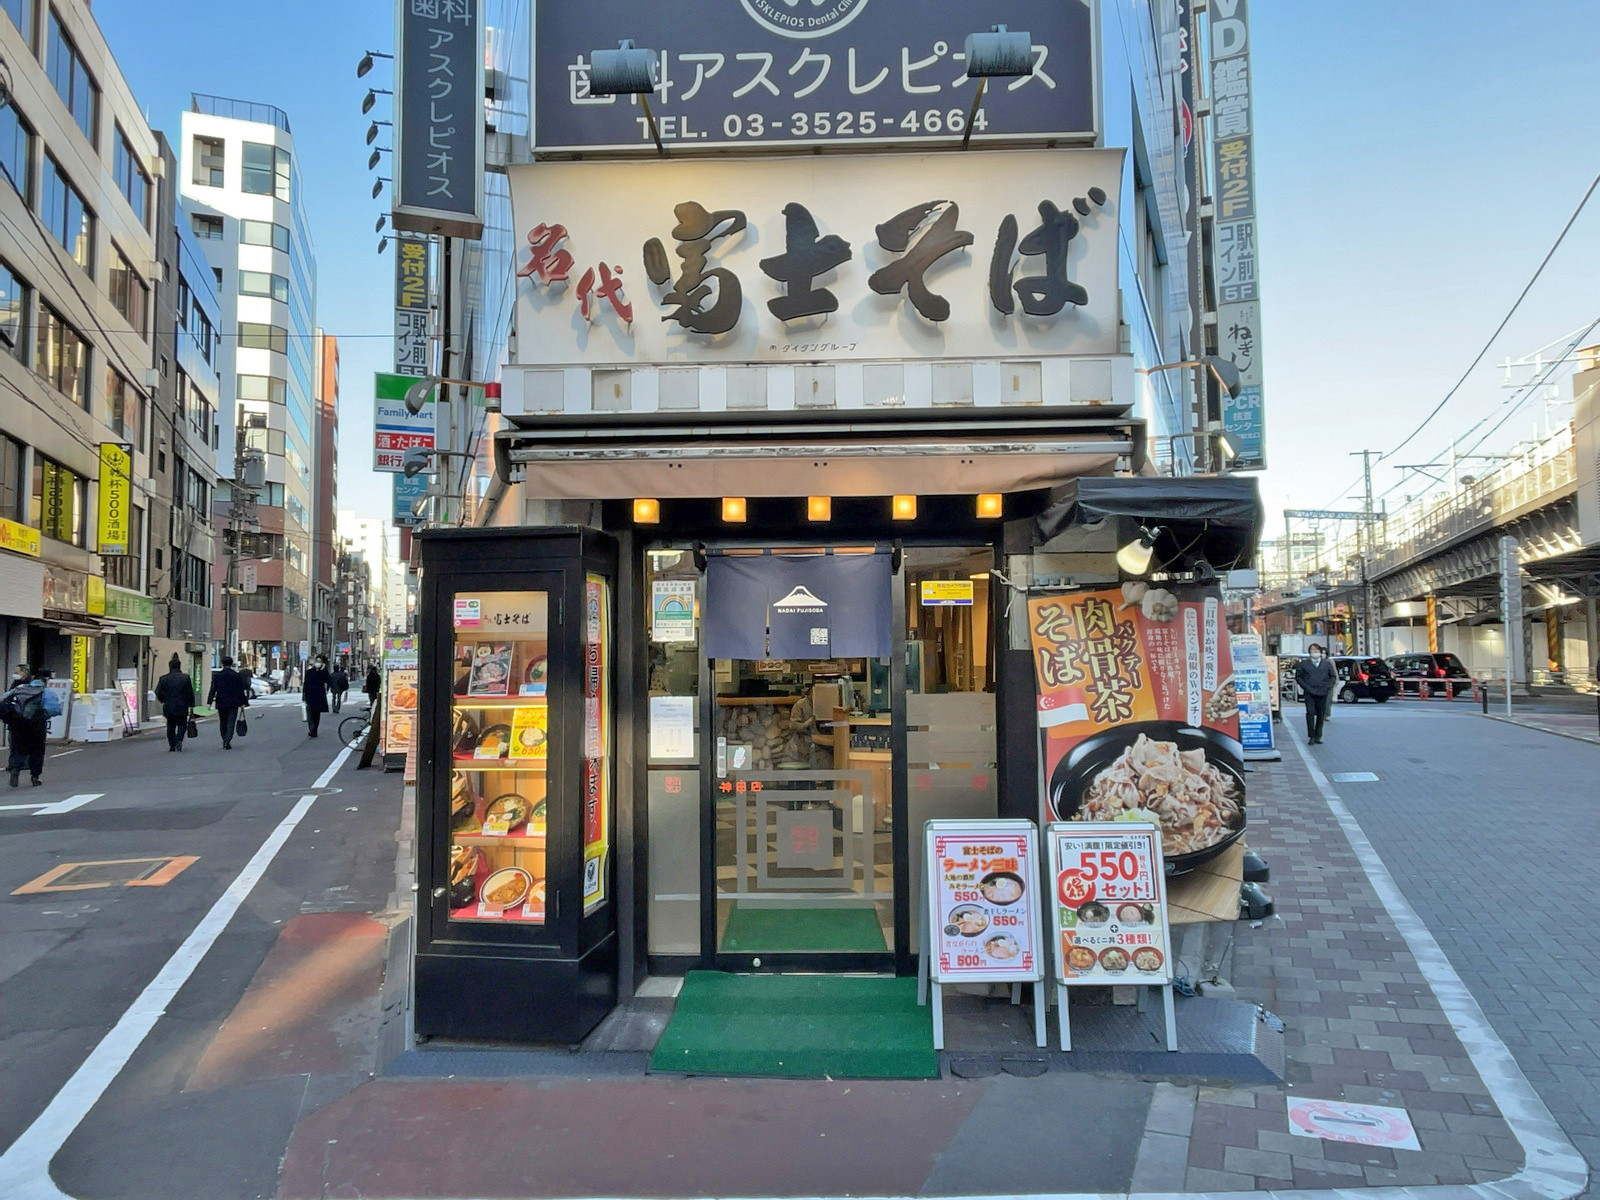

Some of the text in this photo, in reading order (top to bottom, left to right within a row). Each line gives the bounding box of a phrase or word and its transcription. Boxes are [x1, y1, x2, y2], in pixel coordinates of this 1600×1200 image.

[753, 0, 805, 28] SKLEPIOS
[808, 7, 839, 27] Dental
[426, 28, 456, 199] アスクレピオス
[636, 107, 989, 139] TEL. 03-3525-4664
[1213, 57, 1249, 139] 鑑賞
[1220, 139, 1249, 217] 受付2F
[401, 243, 426, 307] 受付2F
[517, 187, 1107, 334] 名代 富士そば
[1220, 225, 1237, 284] コイン
[1236, 223, 1255, 282] 駅前
[1225, 284, 1253, 300] 5F
[398, 313, 412, 362] コイン
[413, 314, 427, 365] 駅前
[782, 342, 859, 353] ダイタングループ
[1223, 394, 1261, 411] PCR
[1225, 422, 1262, 433] センター
[1036, 606, 1083, 685] そば
[1074, 600, 1132, 721] 肉骨茶
[1118, 622, 1140, 686] バクテー
[962, 845, 1004, 856] 富士そばの
[1079, 850, 1139, 881] 550
[1140, 870, 1149, 881] 円
[1101, 881, 1150, 898] セット!
